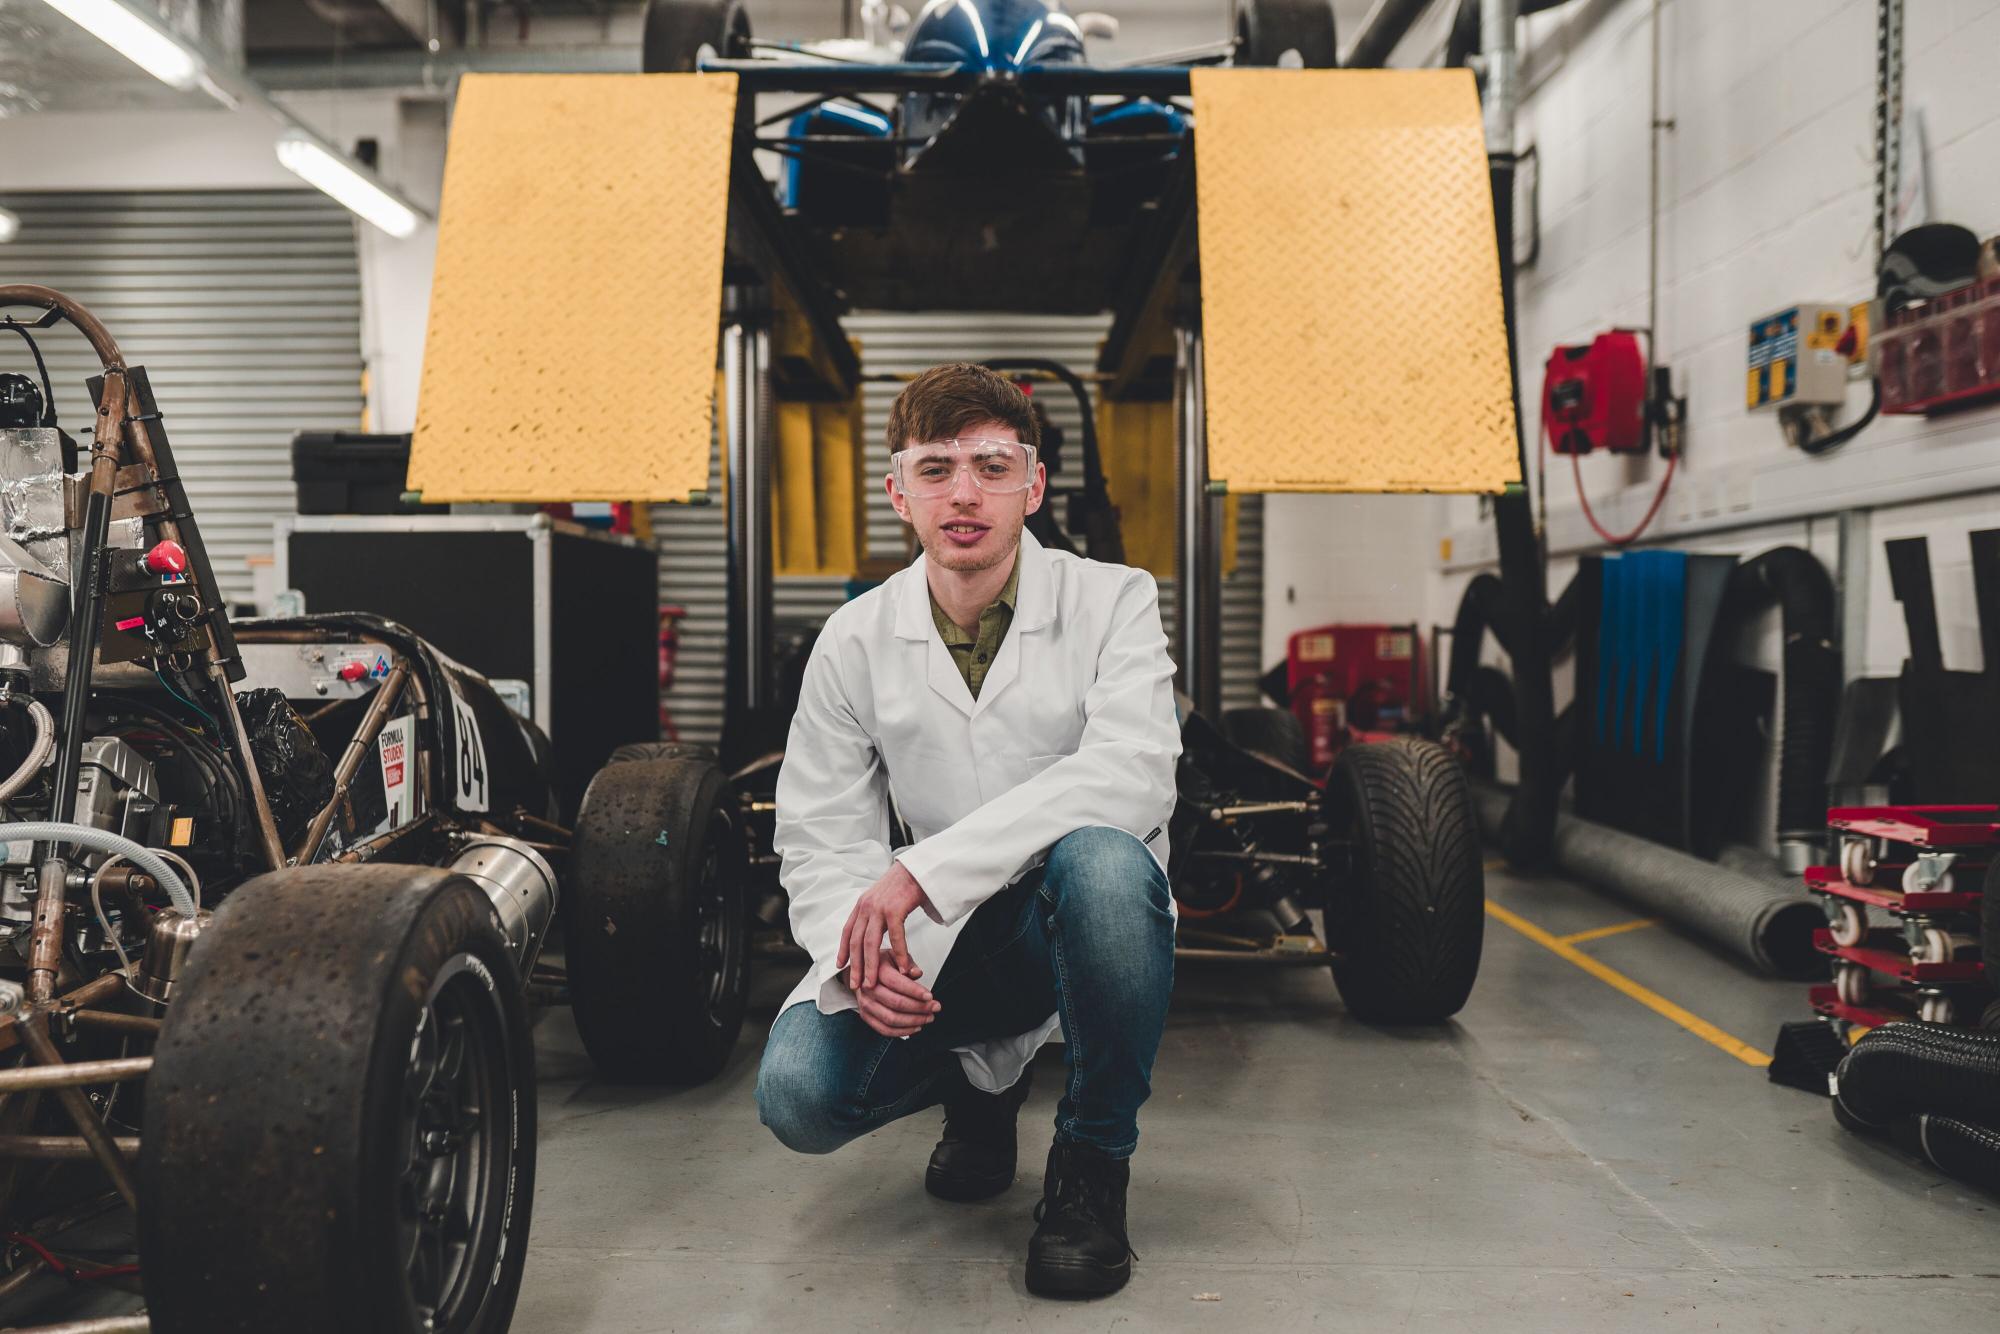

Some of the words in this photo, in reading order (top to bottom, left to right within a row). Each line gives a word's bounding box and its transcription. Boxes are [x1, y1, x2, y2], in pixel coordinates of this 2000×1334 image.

[381, 728, 404, 748] FORMULA
[383, 743, 404, 764] STUDENT
[457, 704, 484, 805] 84
